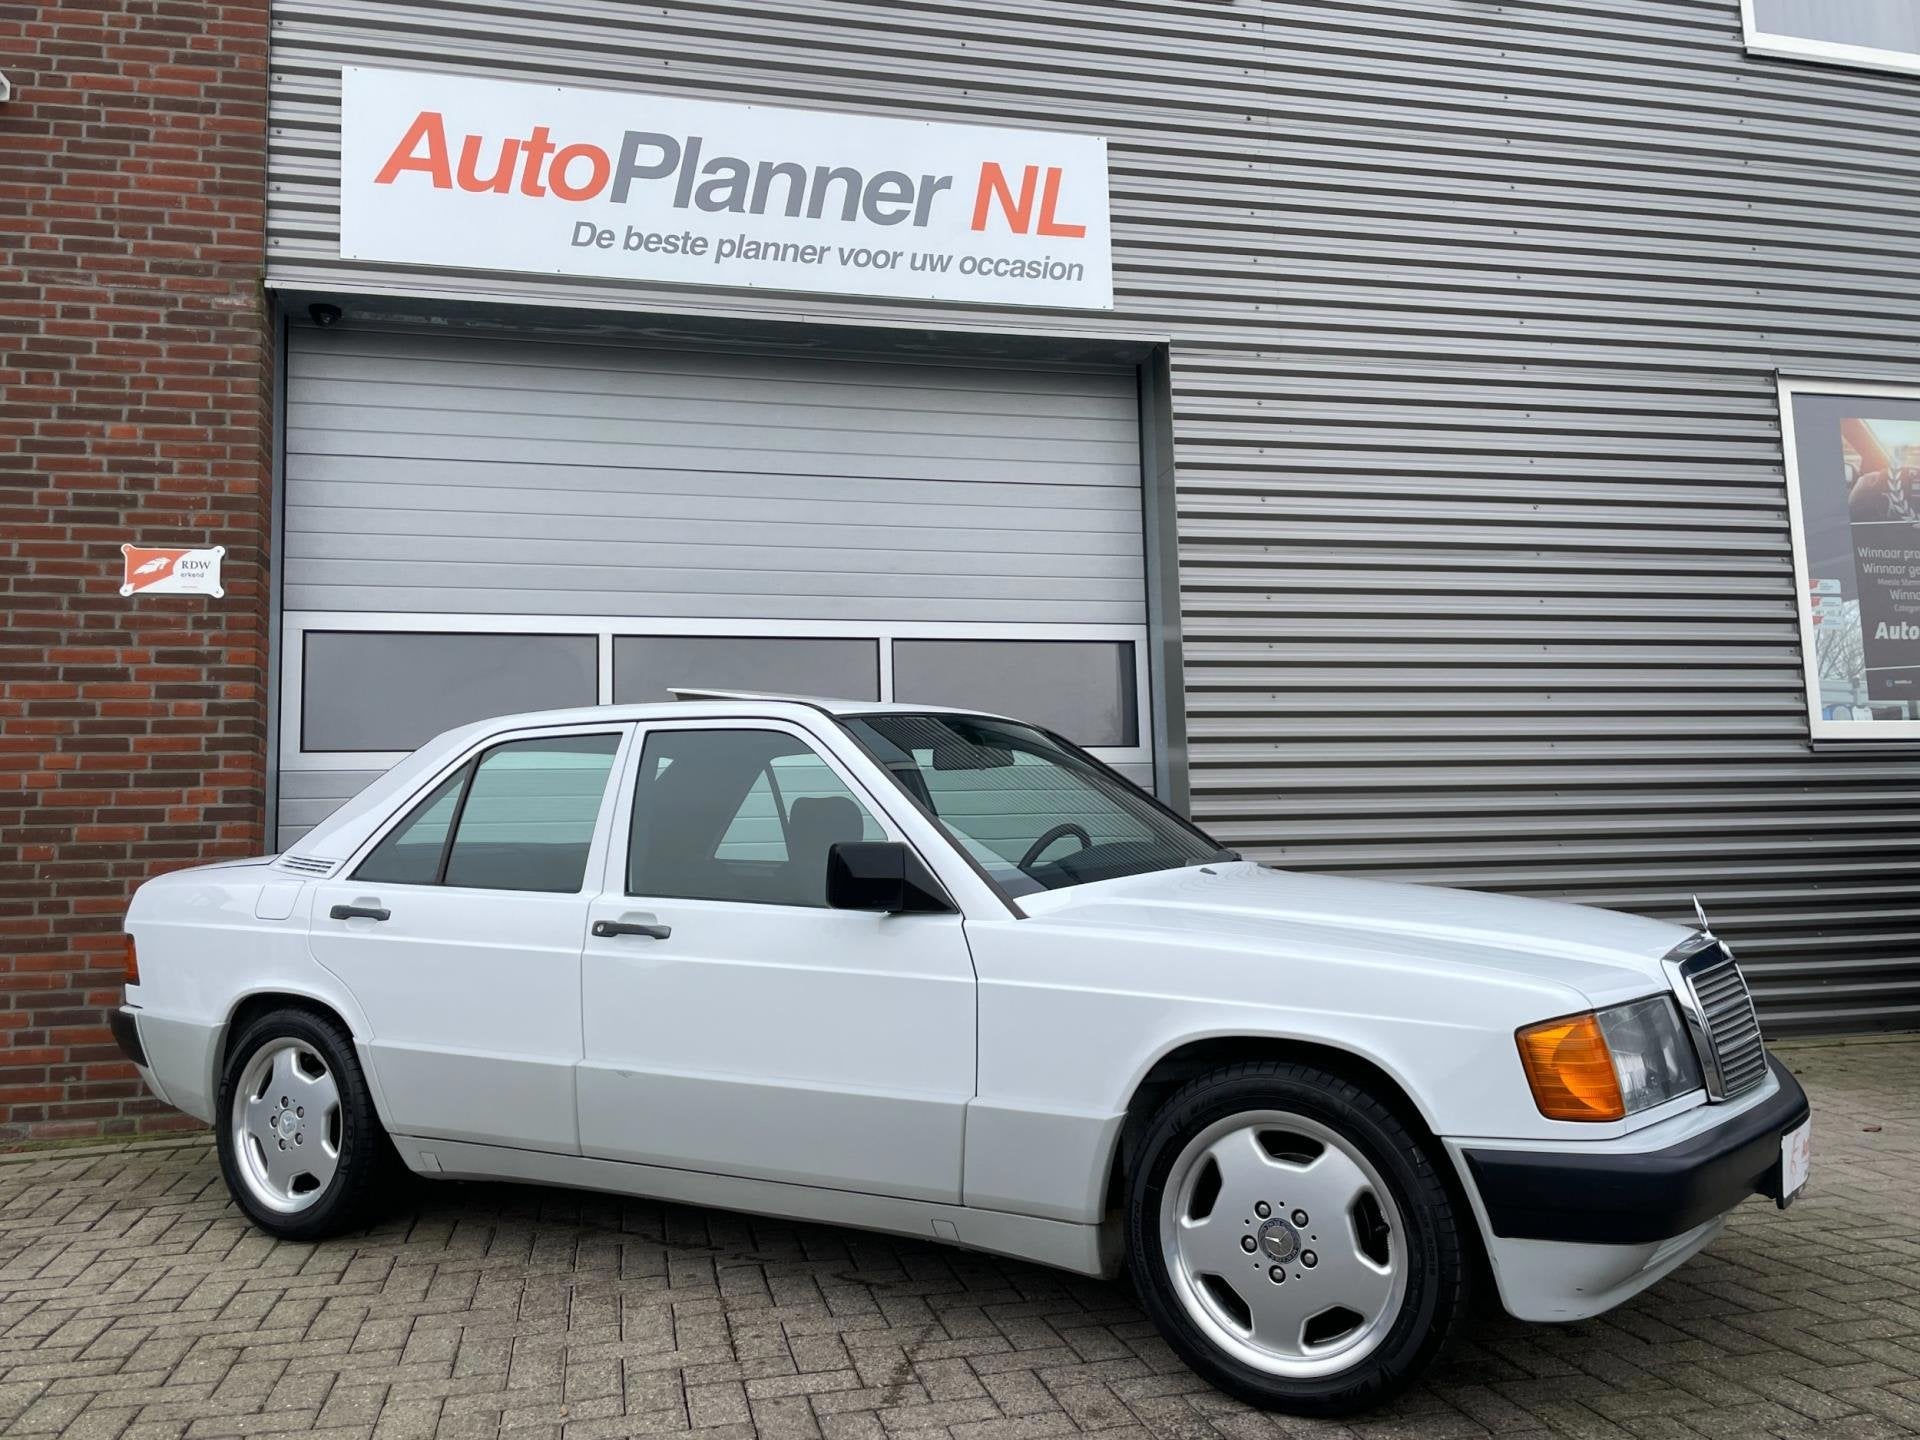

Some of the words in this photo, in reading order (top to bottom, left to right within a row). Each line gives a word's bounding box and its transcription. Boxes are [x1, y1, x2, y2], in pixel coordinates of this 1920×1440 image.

[374, 112, 953, 227] AutoPlanner
[971, 162, 1086, 238] NL
[571, 221, 615, 249] De
[623, 225, 708, 256] beste
[714, 234, 831, 264] planner
[838, 247, 904, 269] voor
[910, 253, 953, 272] uw
[959, 256, 1083, 281] occasion
[1857, 546, 1901, 559] Winnaar
[181, 560, 211, 570] RDW
[1862, 562, 1905, 574] Winnaar
[1874, 621, 1920, 640] Auto
